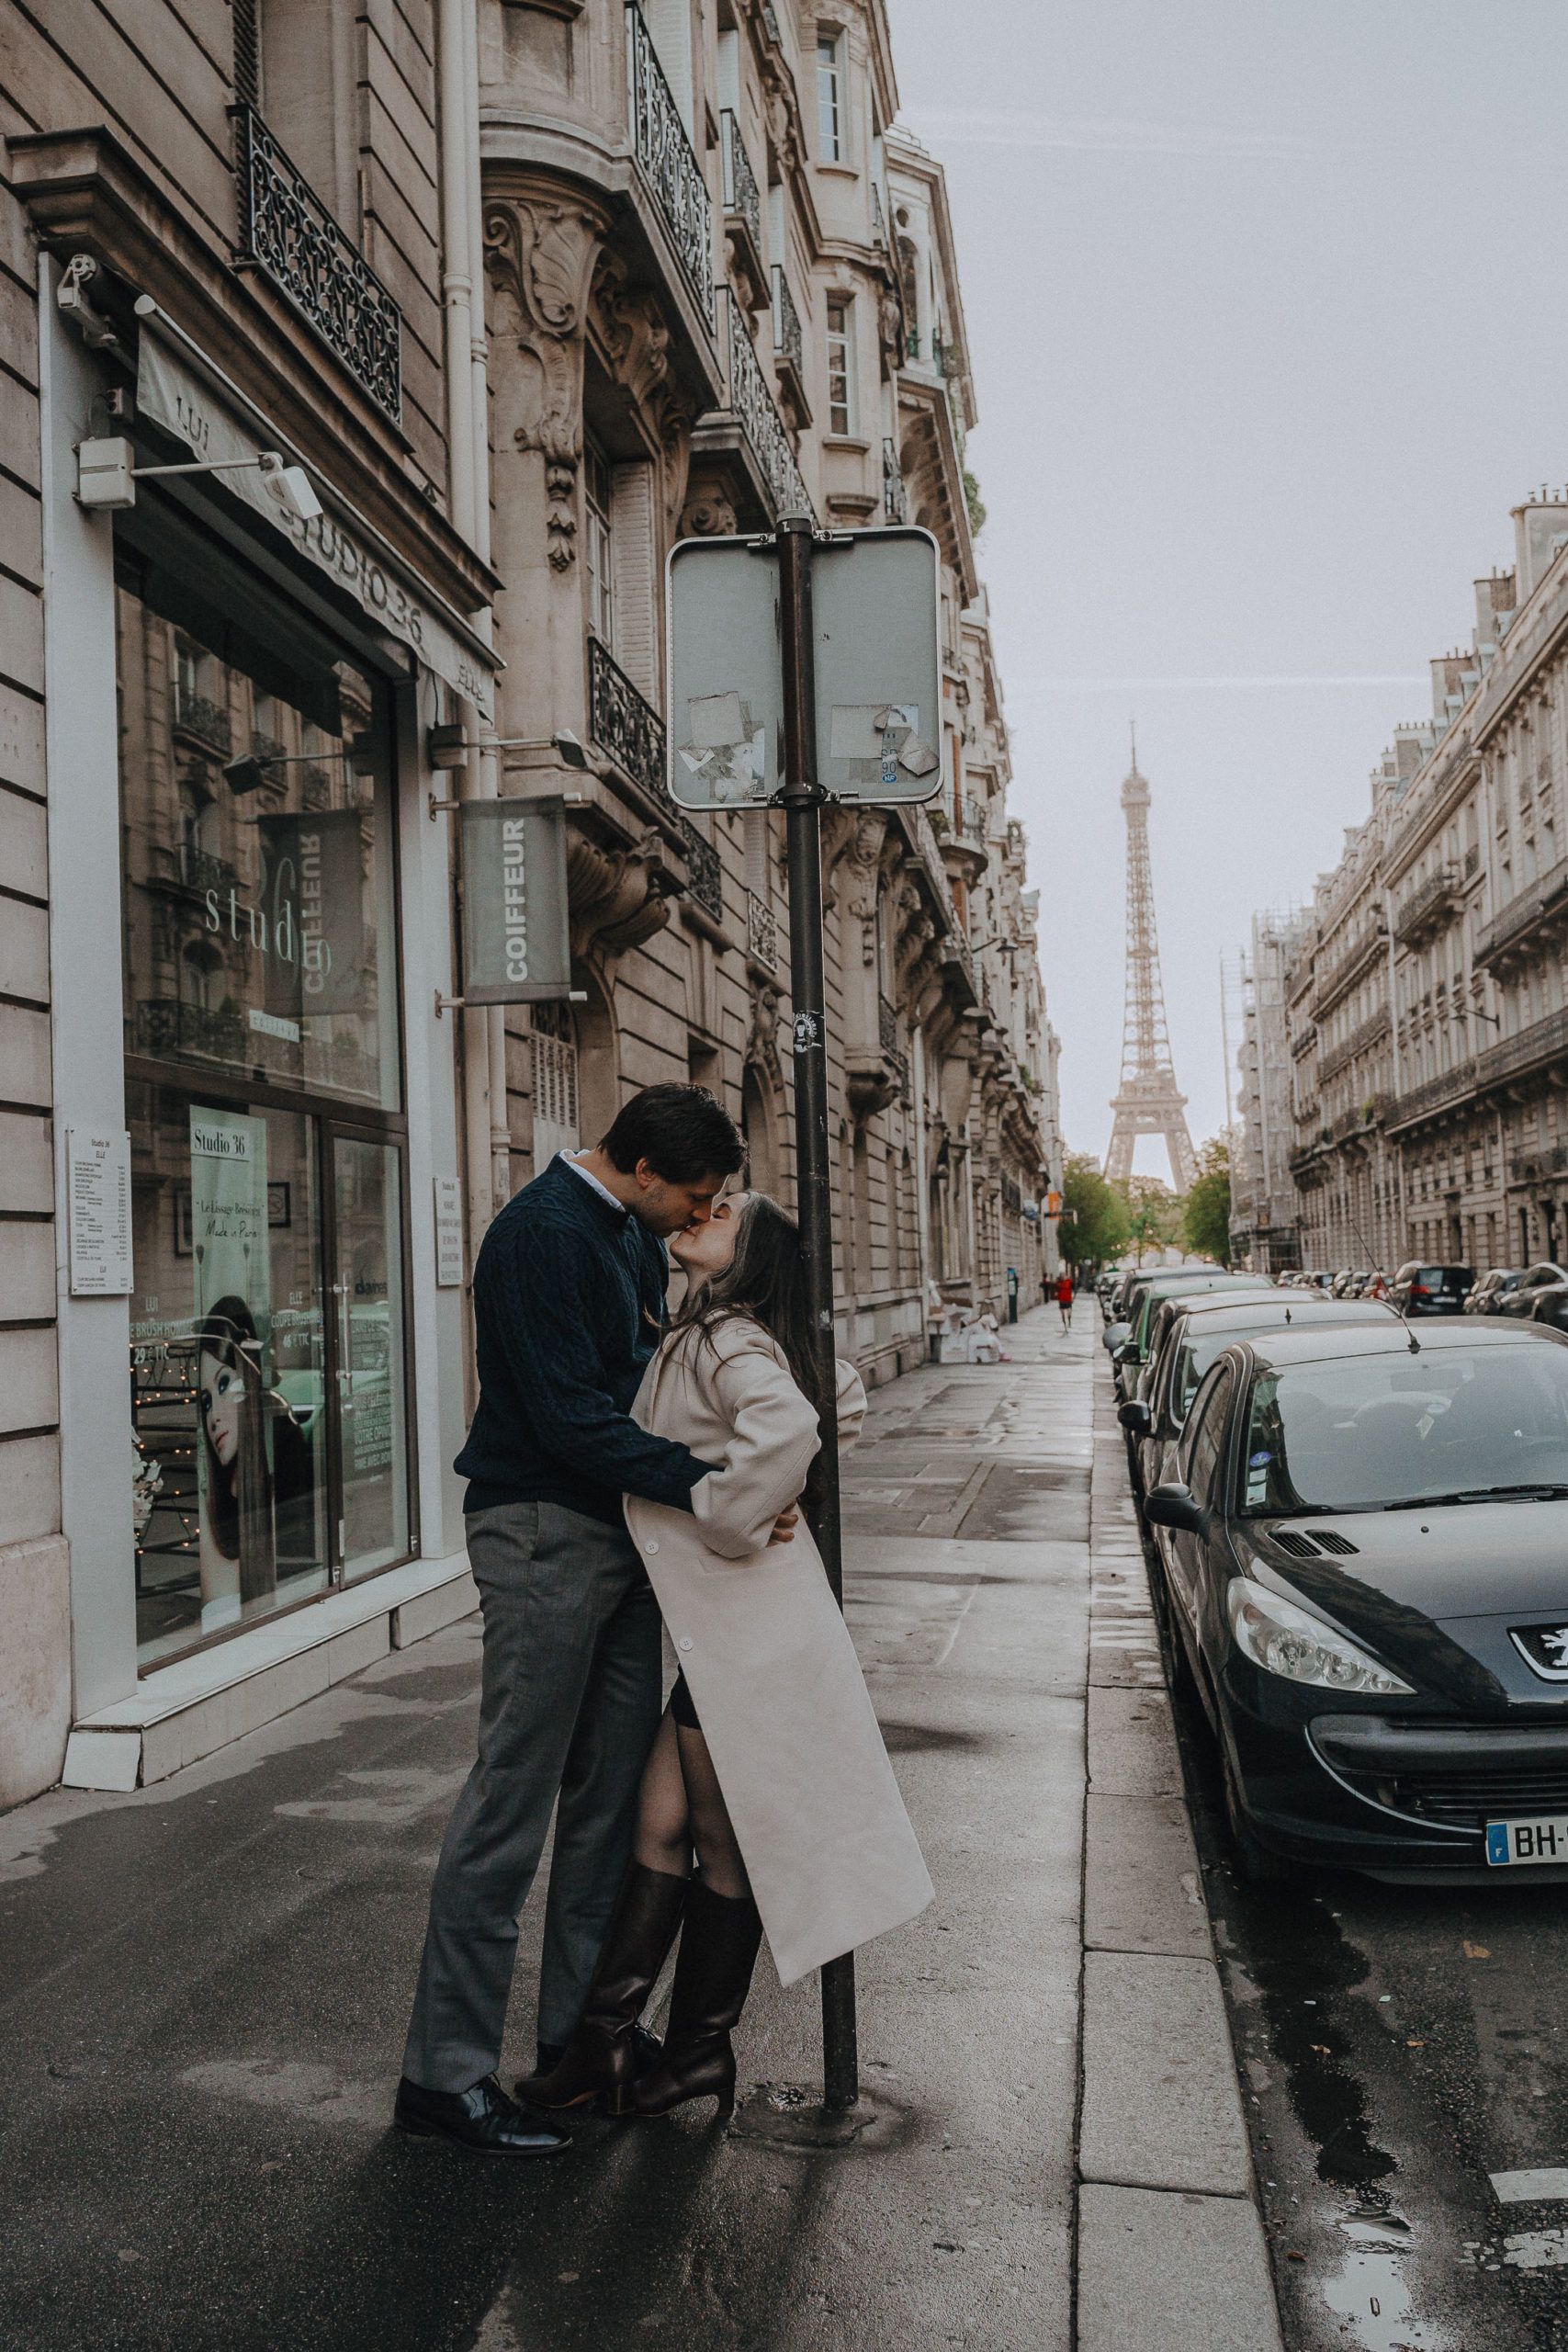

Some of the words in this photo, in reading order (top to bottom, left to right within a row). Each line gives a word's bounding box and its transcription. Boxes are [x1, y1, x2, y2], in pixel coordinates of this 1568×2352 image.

[388, 589, 423, 645] 36
[882, 762, 897, 774] 90
[502, 818, 528, 982] COIFFEUR
[205, 888, 332, 977] studio
[194, 1128, 230, 1154] Studio
[232, 1134, 246, 1156] 36
[205, 1218, 229, 1238] Made
[145, 1295, 159, 1313] LUI
[136, 1319, 163, 1338] BRUSH
[134, 1347, 146, 1365] 29
[155, 1344, 170, 1363] TTC
[1515, 1825, 1568, 1858] BH-
[1495, 1848, 1503, 1858] F
